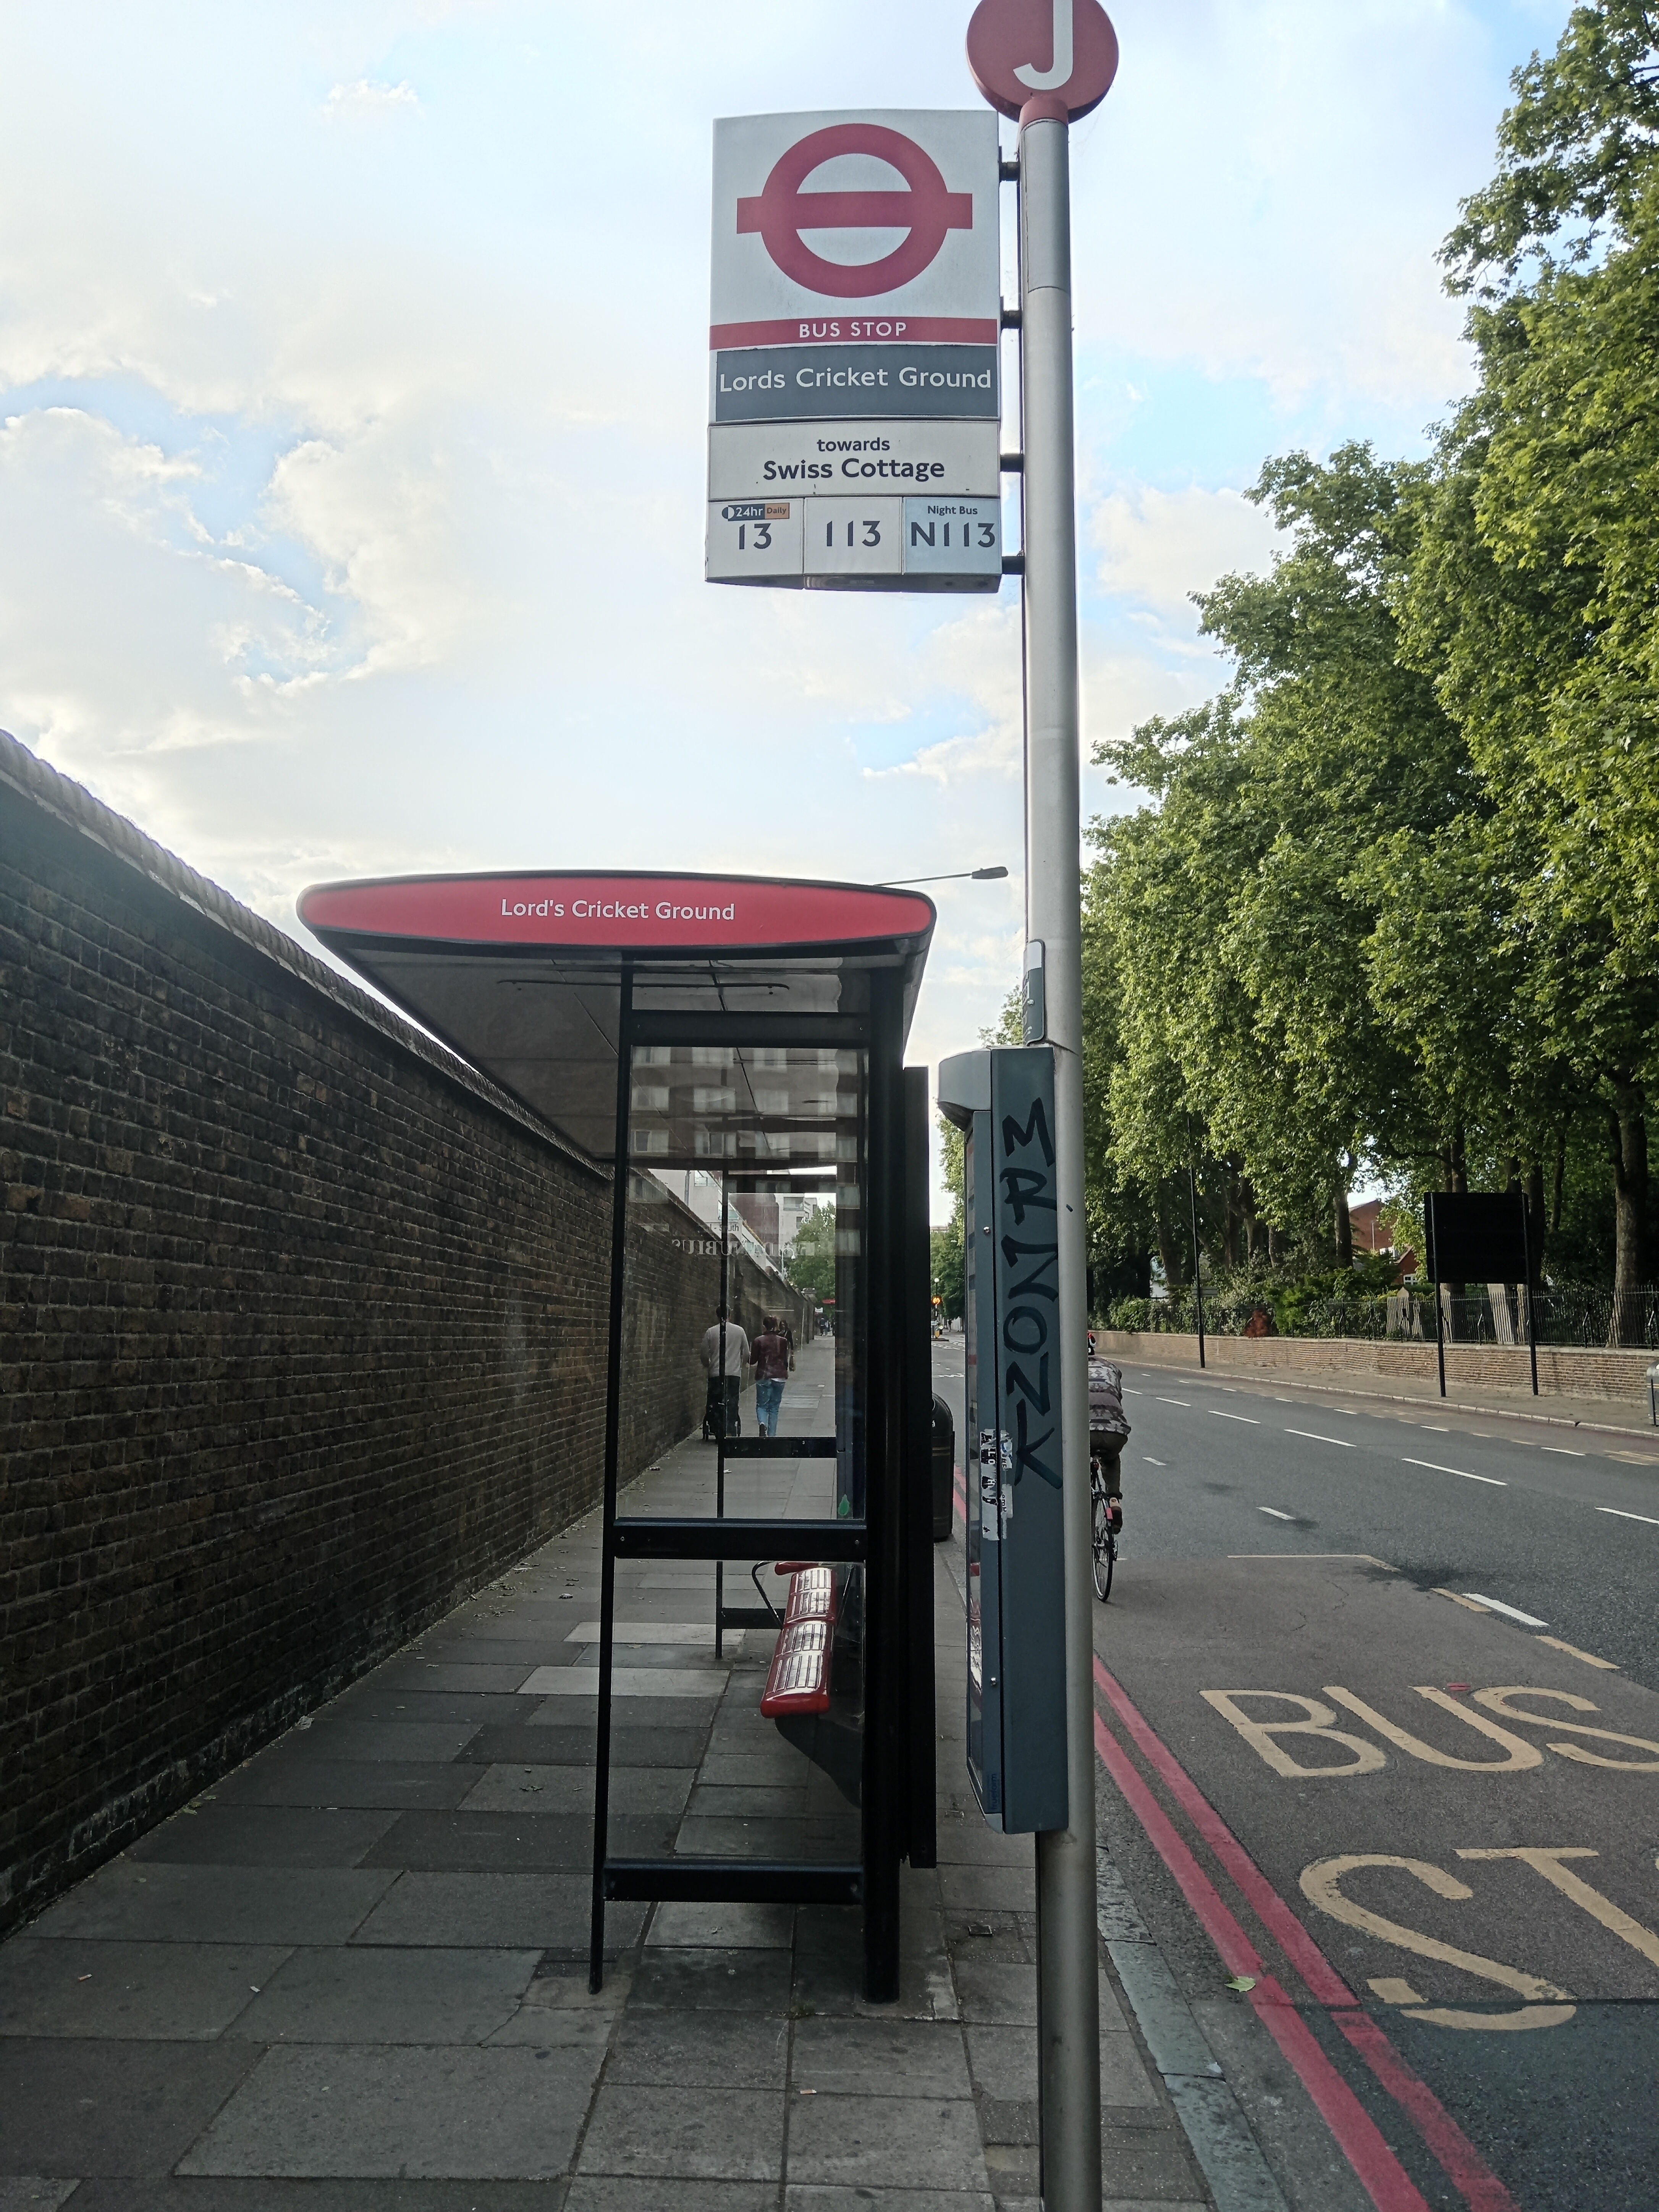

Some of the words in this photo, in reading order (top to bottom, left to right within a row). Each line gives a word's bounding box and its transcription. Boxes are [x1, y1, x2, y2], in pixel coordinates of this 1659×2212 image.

[1013, 0, 1073, 90] J
[799, 323, 841, 338] BUS
[851, 321, 907, 337] STOP
[720, 370, 786, 392] Lords
[796, 367, 888, 387] Cricket
[899, 367, 991, 388] Ground
[817, 437, 890, 452] towards
[763, 459, 833, 480] Swiss
[841, 458, 945, 482] Cottage
[736, 506, 763, 517] 24hr
[927, 506, 957, 516] Night
[959, 506, 978, 515] Bus
[739, 523, 772, 550] 13
[826, 521, 881, 547] 113
[911, 521, 996, 548] N113
[501, 899, 564, 917] Lord's
[572, 900, 649, 918] Cricket
[655, 902, 734, 920] Ground
[1198, 1686, 1659, 1777] BUS
[1300, 1847, 1659, 2030] ST
